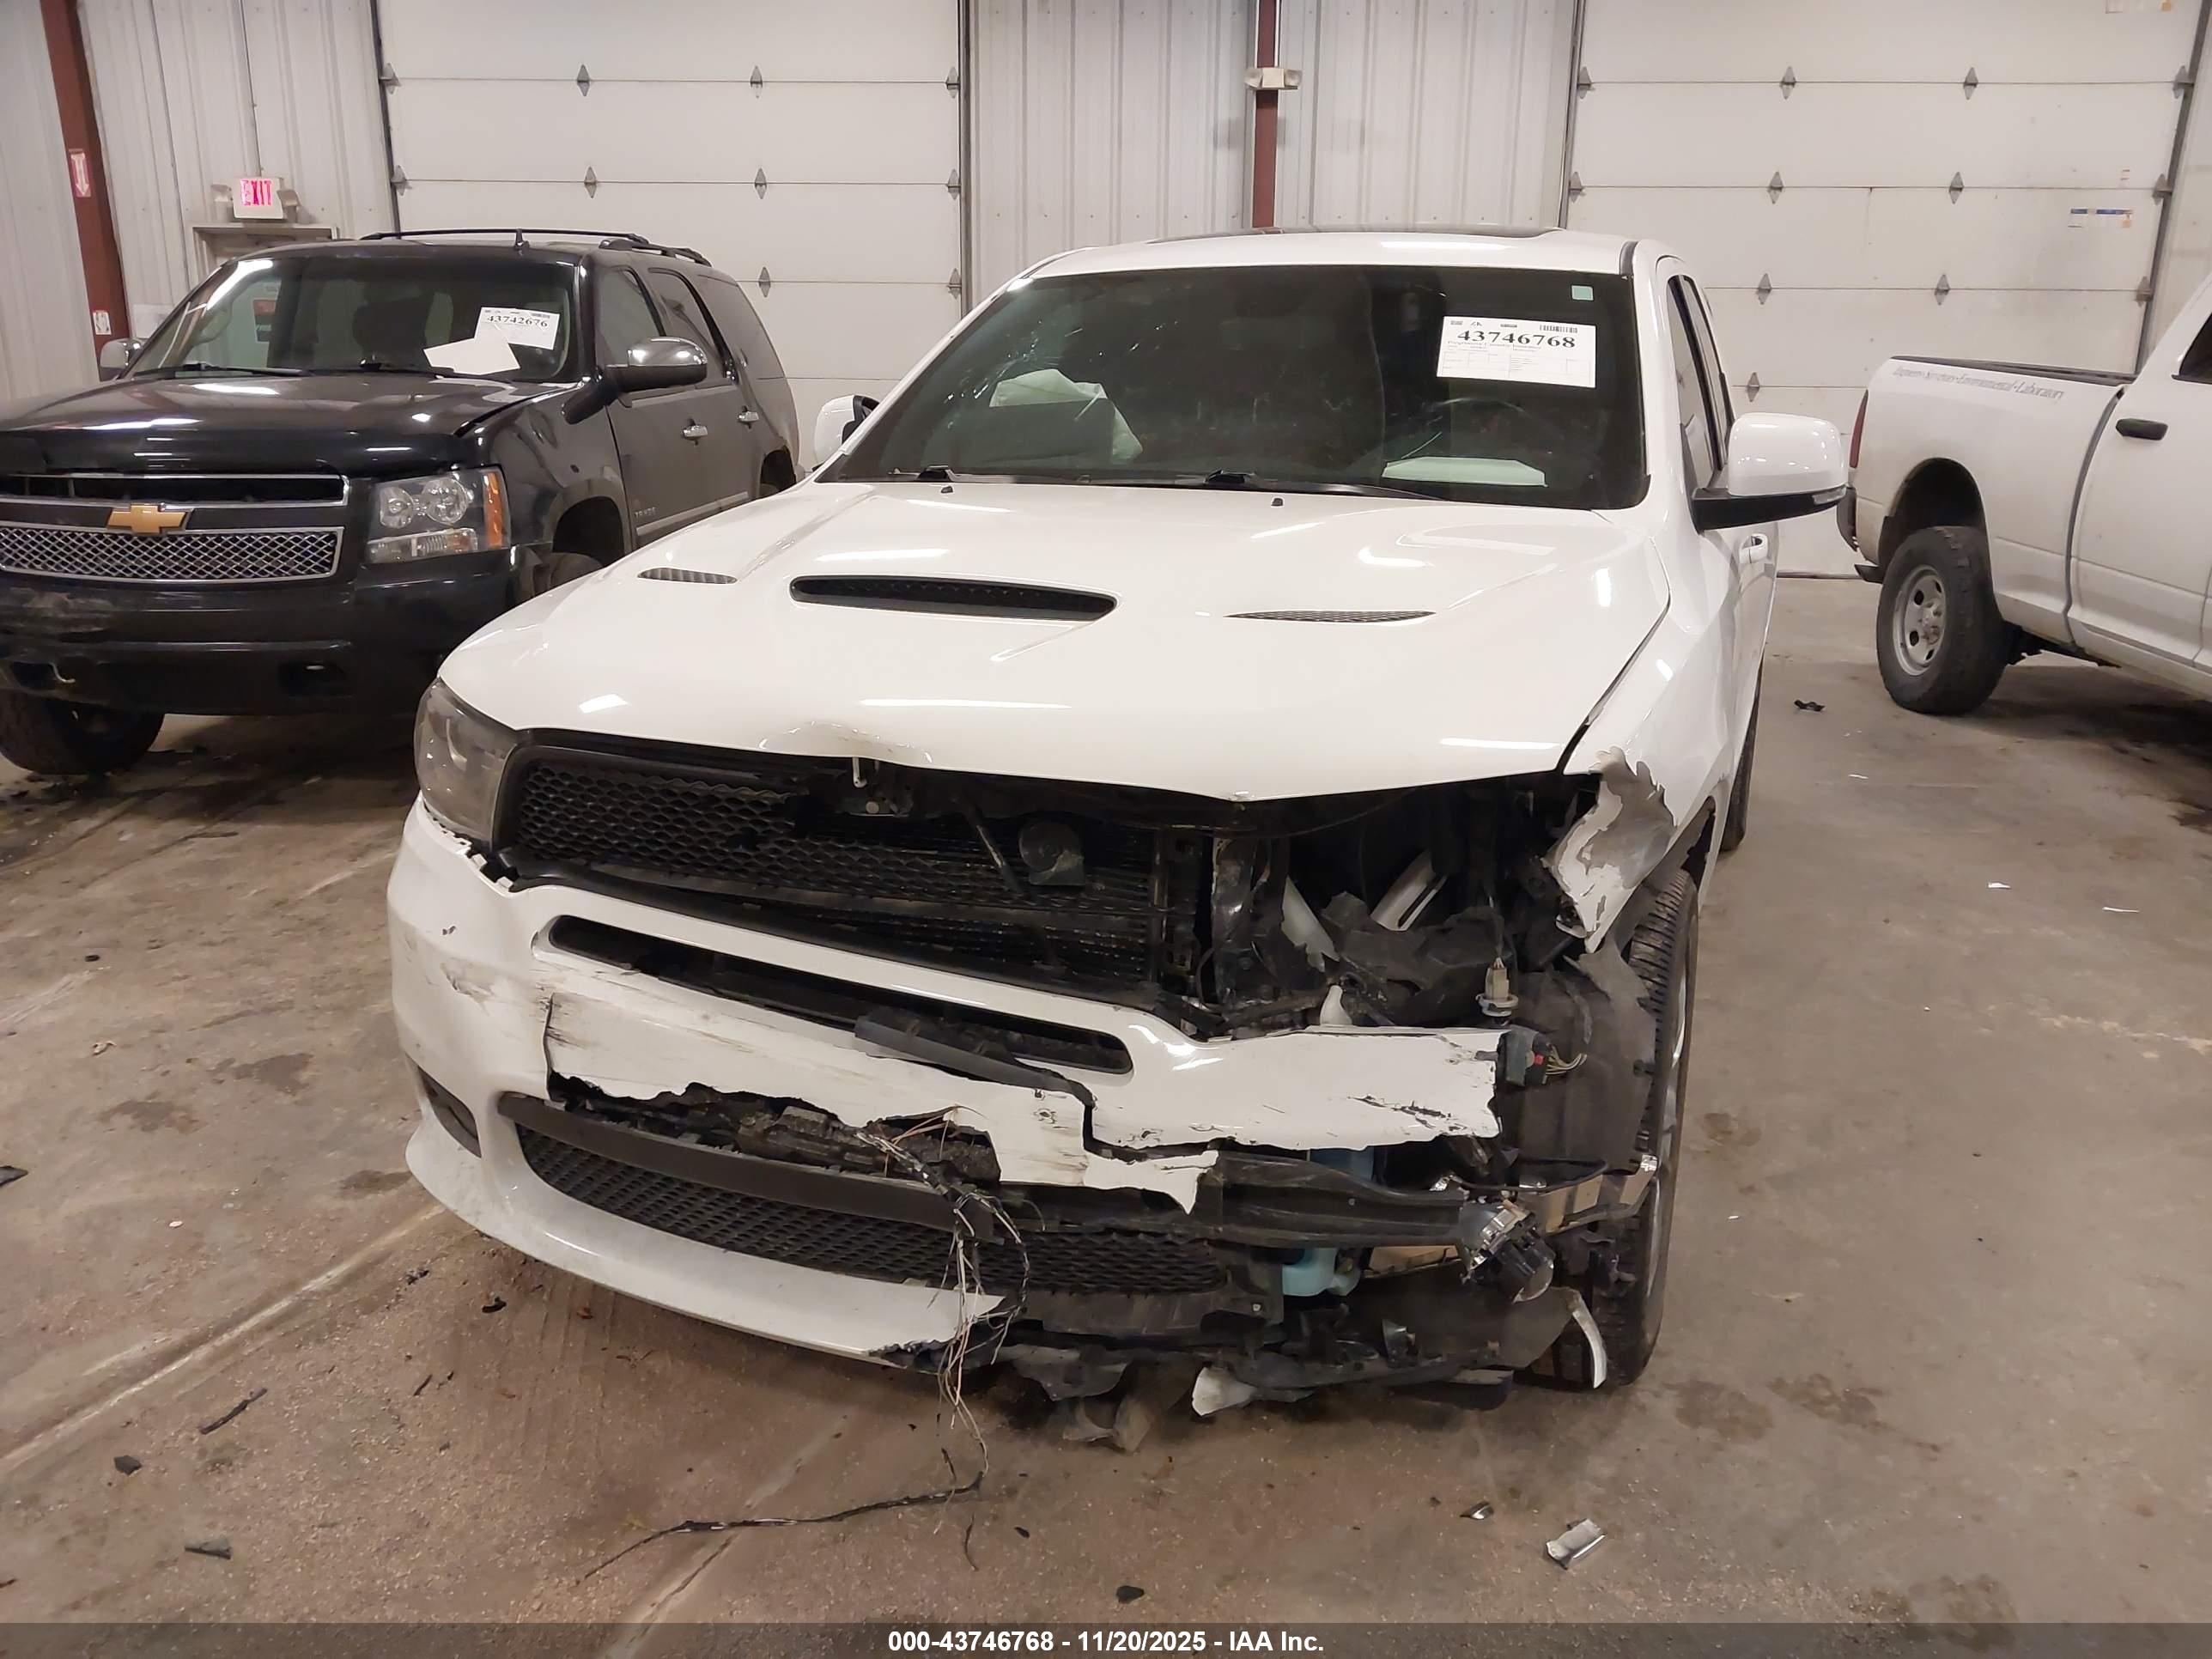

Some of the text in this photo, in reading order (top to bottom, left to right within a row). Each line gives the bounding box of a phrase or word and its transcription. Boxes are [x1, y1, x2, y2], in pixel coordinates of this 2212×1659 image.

[240, 178, 273, 206] EXIT
[487, 315, 548, 327] 43742676
[1457, 330, 1576, 348] 43746768
